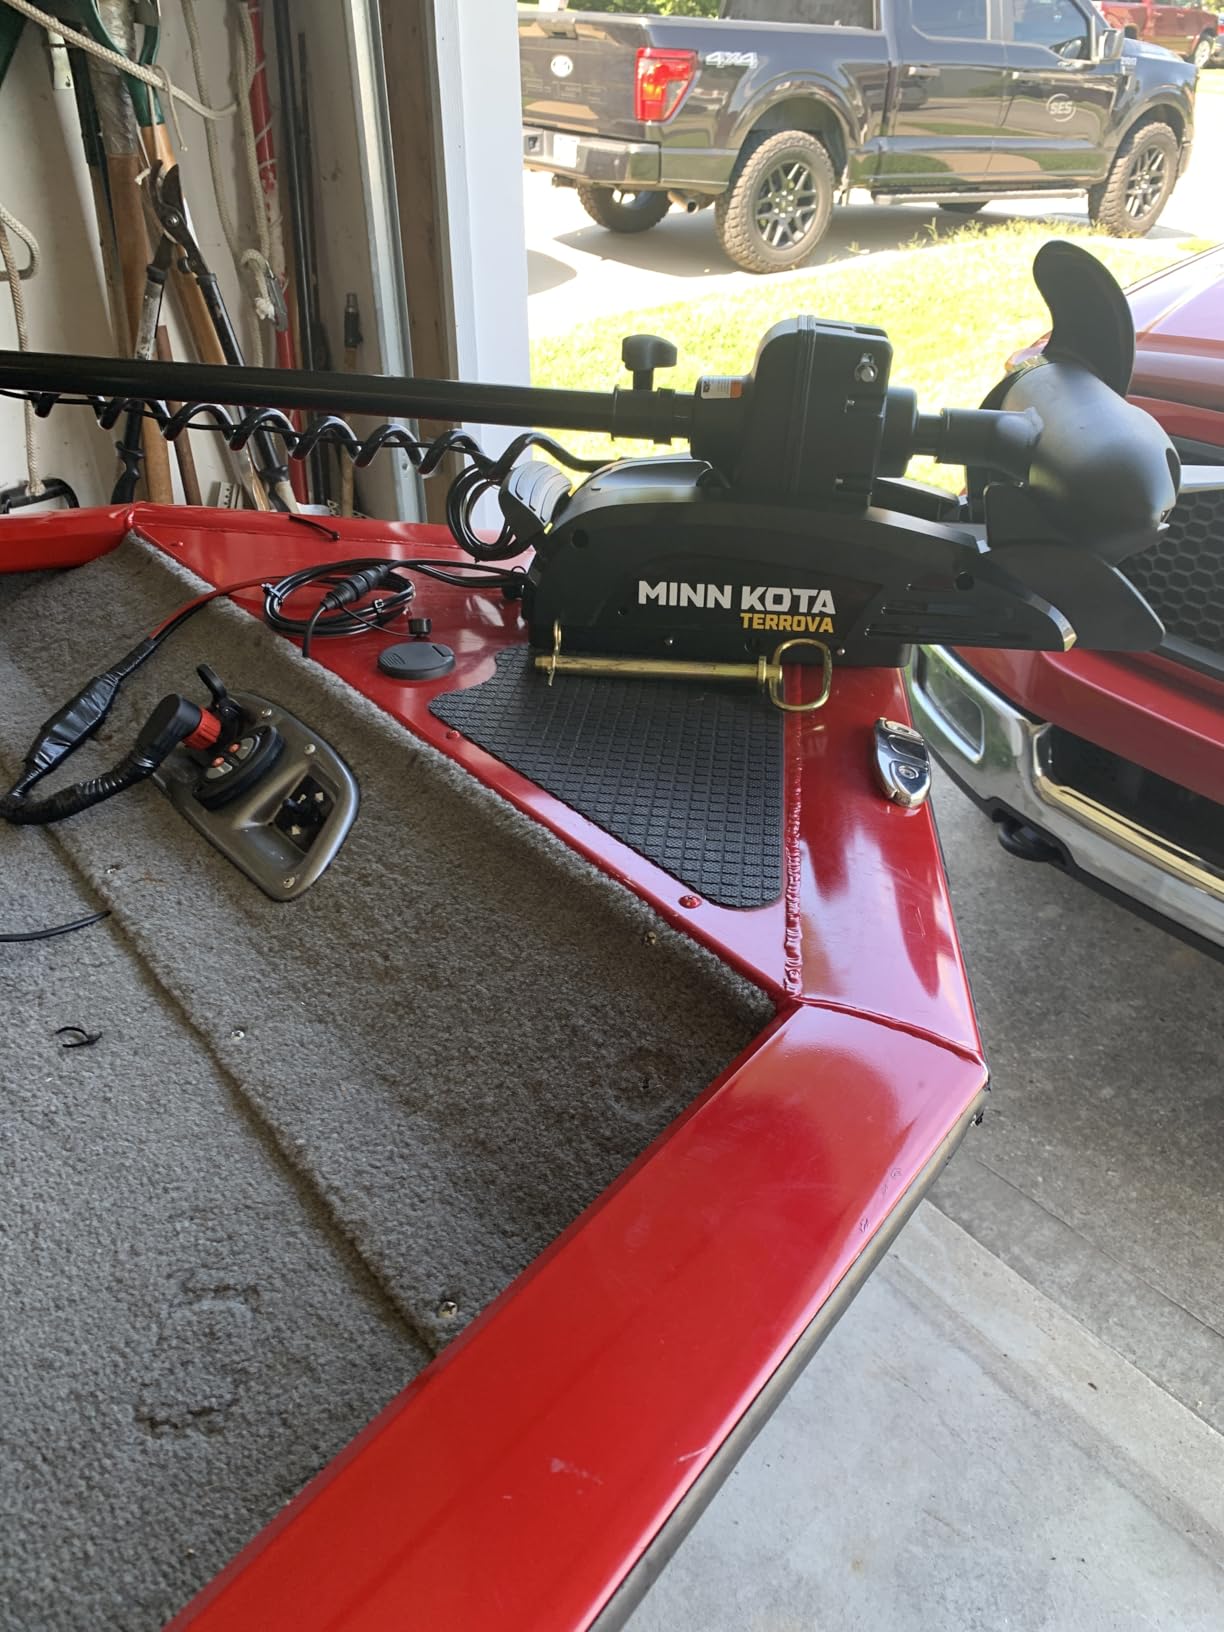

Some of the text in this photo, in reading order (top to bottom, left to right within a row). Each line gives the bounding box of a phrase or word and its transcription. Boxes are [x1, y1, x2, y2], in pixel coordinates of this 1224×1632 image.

[1050, 101, 1073, 115] SES
[638, 580, 836, 615] MINN KOTA
[739, 612, 834, 633] TERROVA
